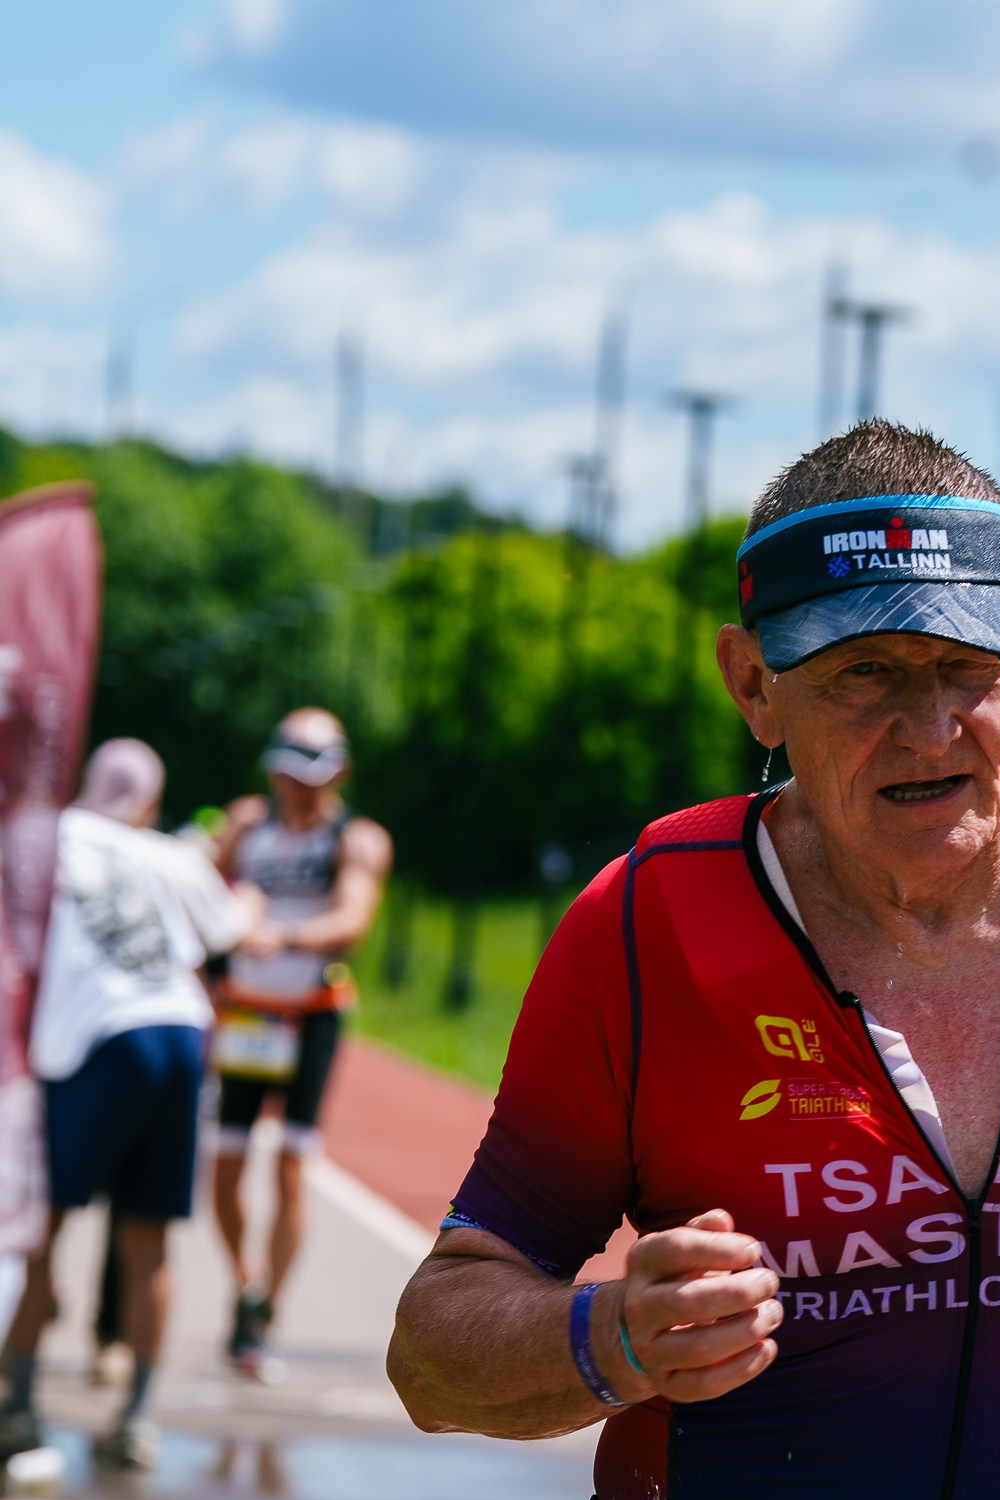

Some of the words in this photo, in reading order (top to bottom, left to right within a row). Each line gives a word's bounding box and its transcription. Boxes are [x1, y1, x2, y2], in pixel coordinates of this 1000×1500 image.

[823, 517, 949, 554] IRONMAN
[852, 553, 951, 569] TALLINN
[788, 1084, 825, 1097] SUPER
[788, 1097, 871, 1115] TRIATHLON
